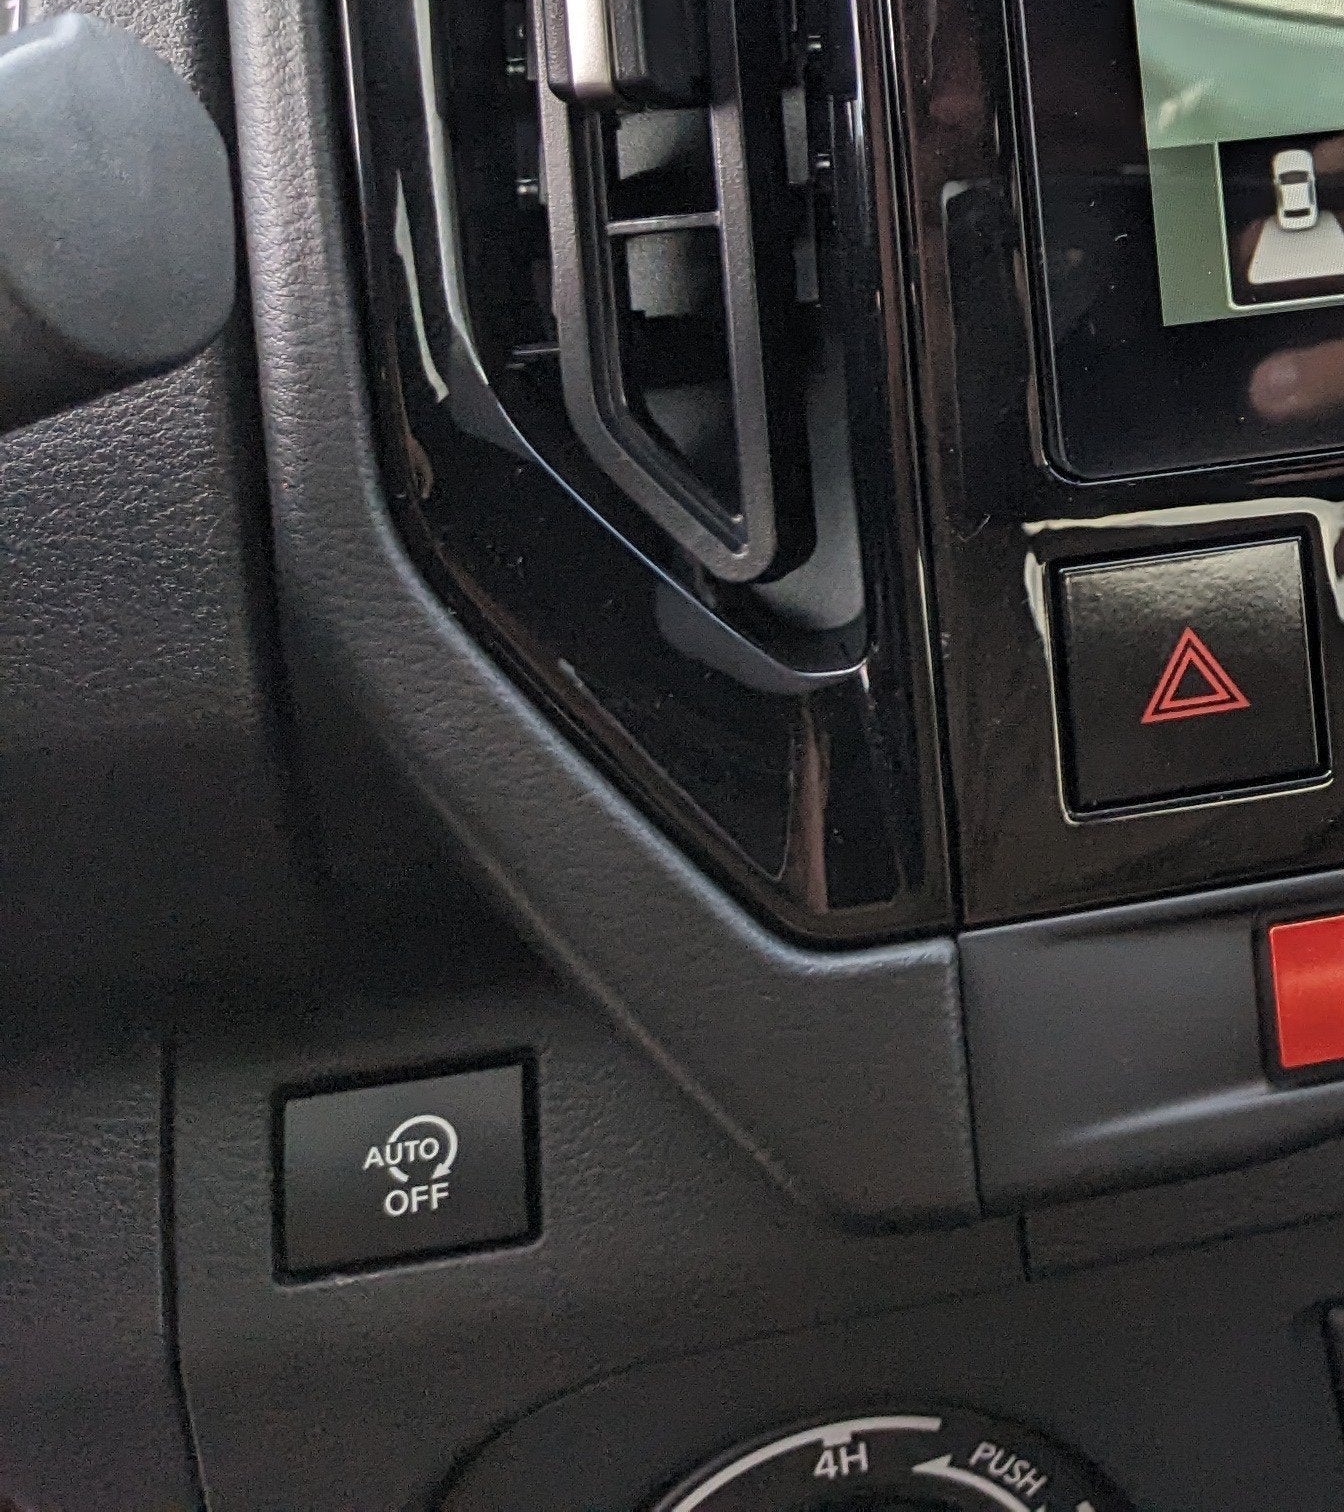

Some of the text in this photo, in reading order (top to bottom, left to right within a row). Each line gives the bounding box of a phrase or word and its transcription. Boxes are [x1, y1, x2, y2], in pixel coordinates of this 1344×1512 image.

[363, 1136, 439, 1170] AUTO
[384, 1181, 449, 1217] OFF
[814, 1441, 869, 1480] 4H
[969, 1441, 1048, 1498] PUSH
